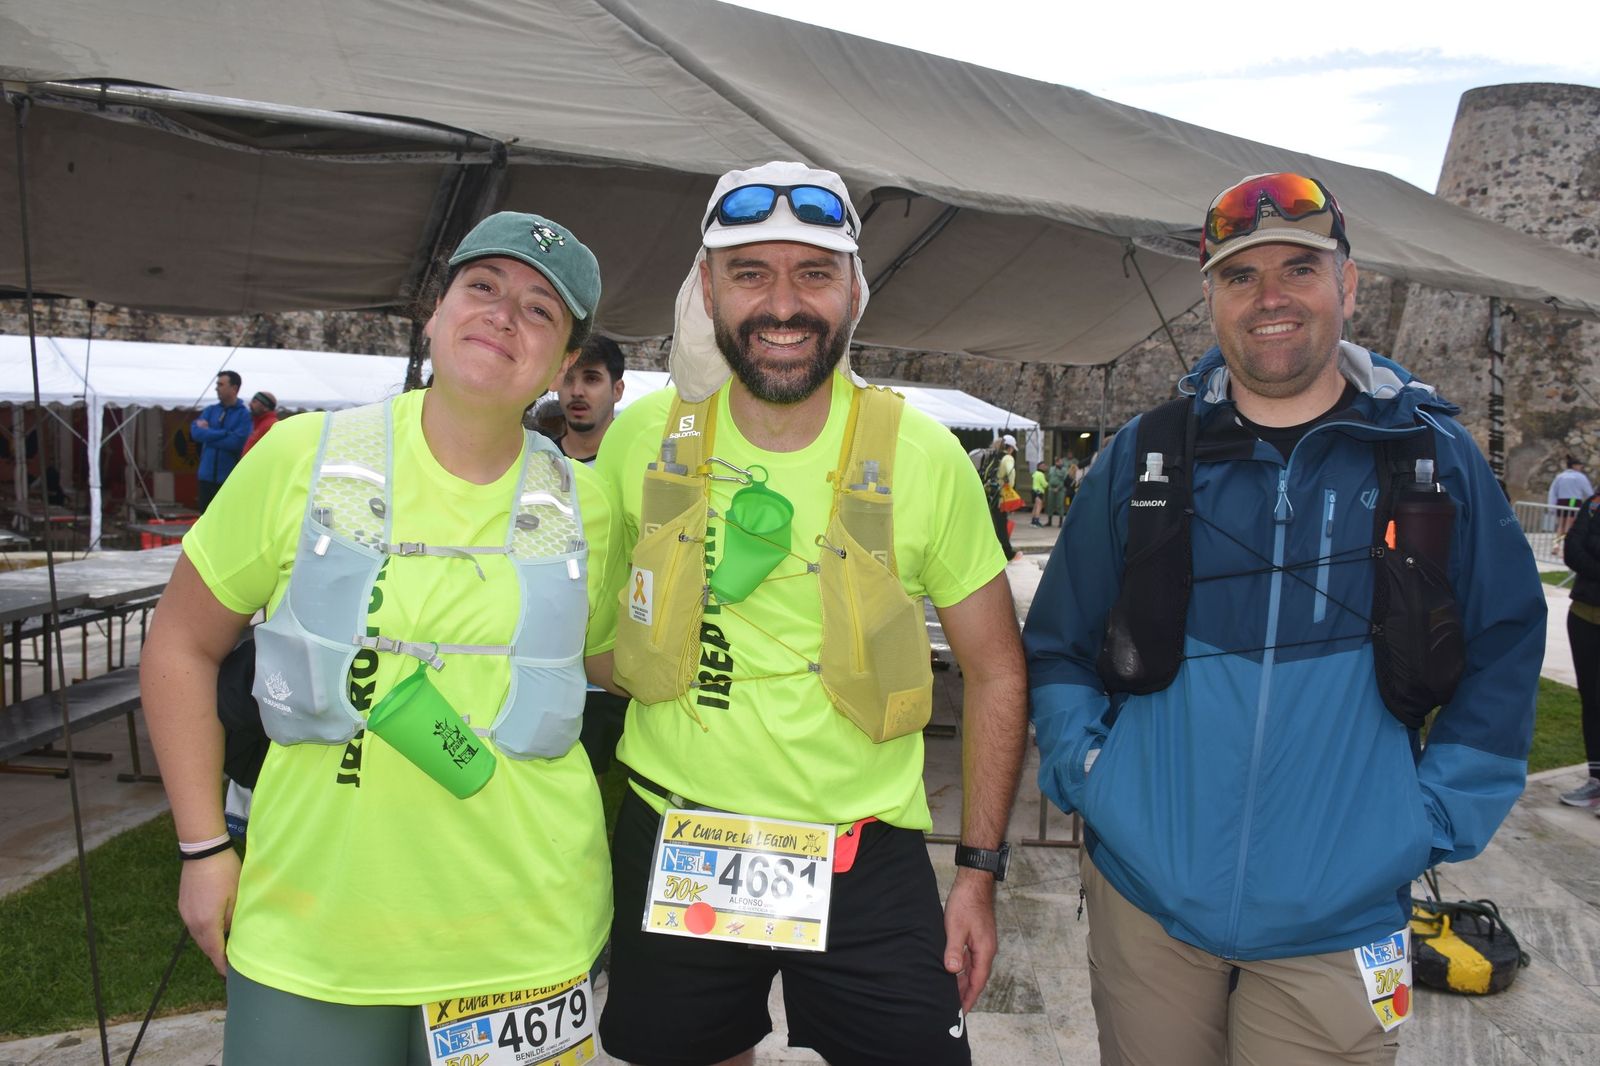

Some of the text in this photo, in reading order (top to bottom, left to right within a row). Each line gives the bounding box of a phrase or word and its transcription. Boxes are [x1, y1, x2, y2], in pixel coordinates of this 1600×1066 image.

[1130, 499, 1167, 507] SALOMON
[672, 818, 692, 839] X
[718, 852, 817, 899] 4681
[729, 896, 763, 907] ALFONSO
[437, 999, 452, 1023] X
[498, 988, 588, 1053] 4679
[516, 1046, 546, 1062] BENILDE
